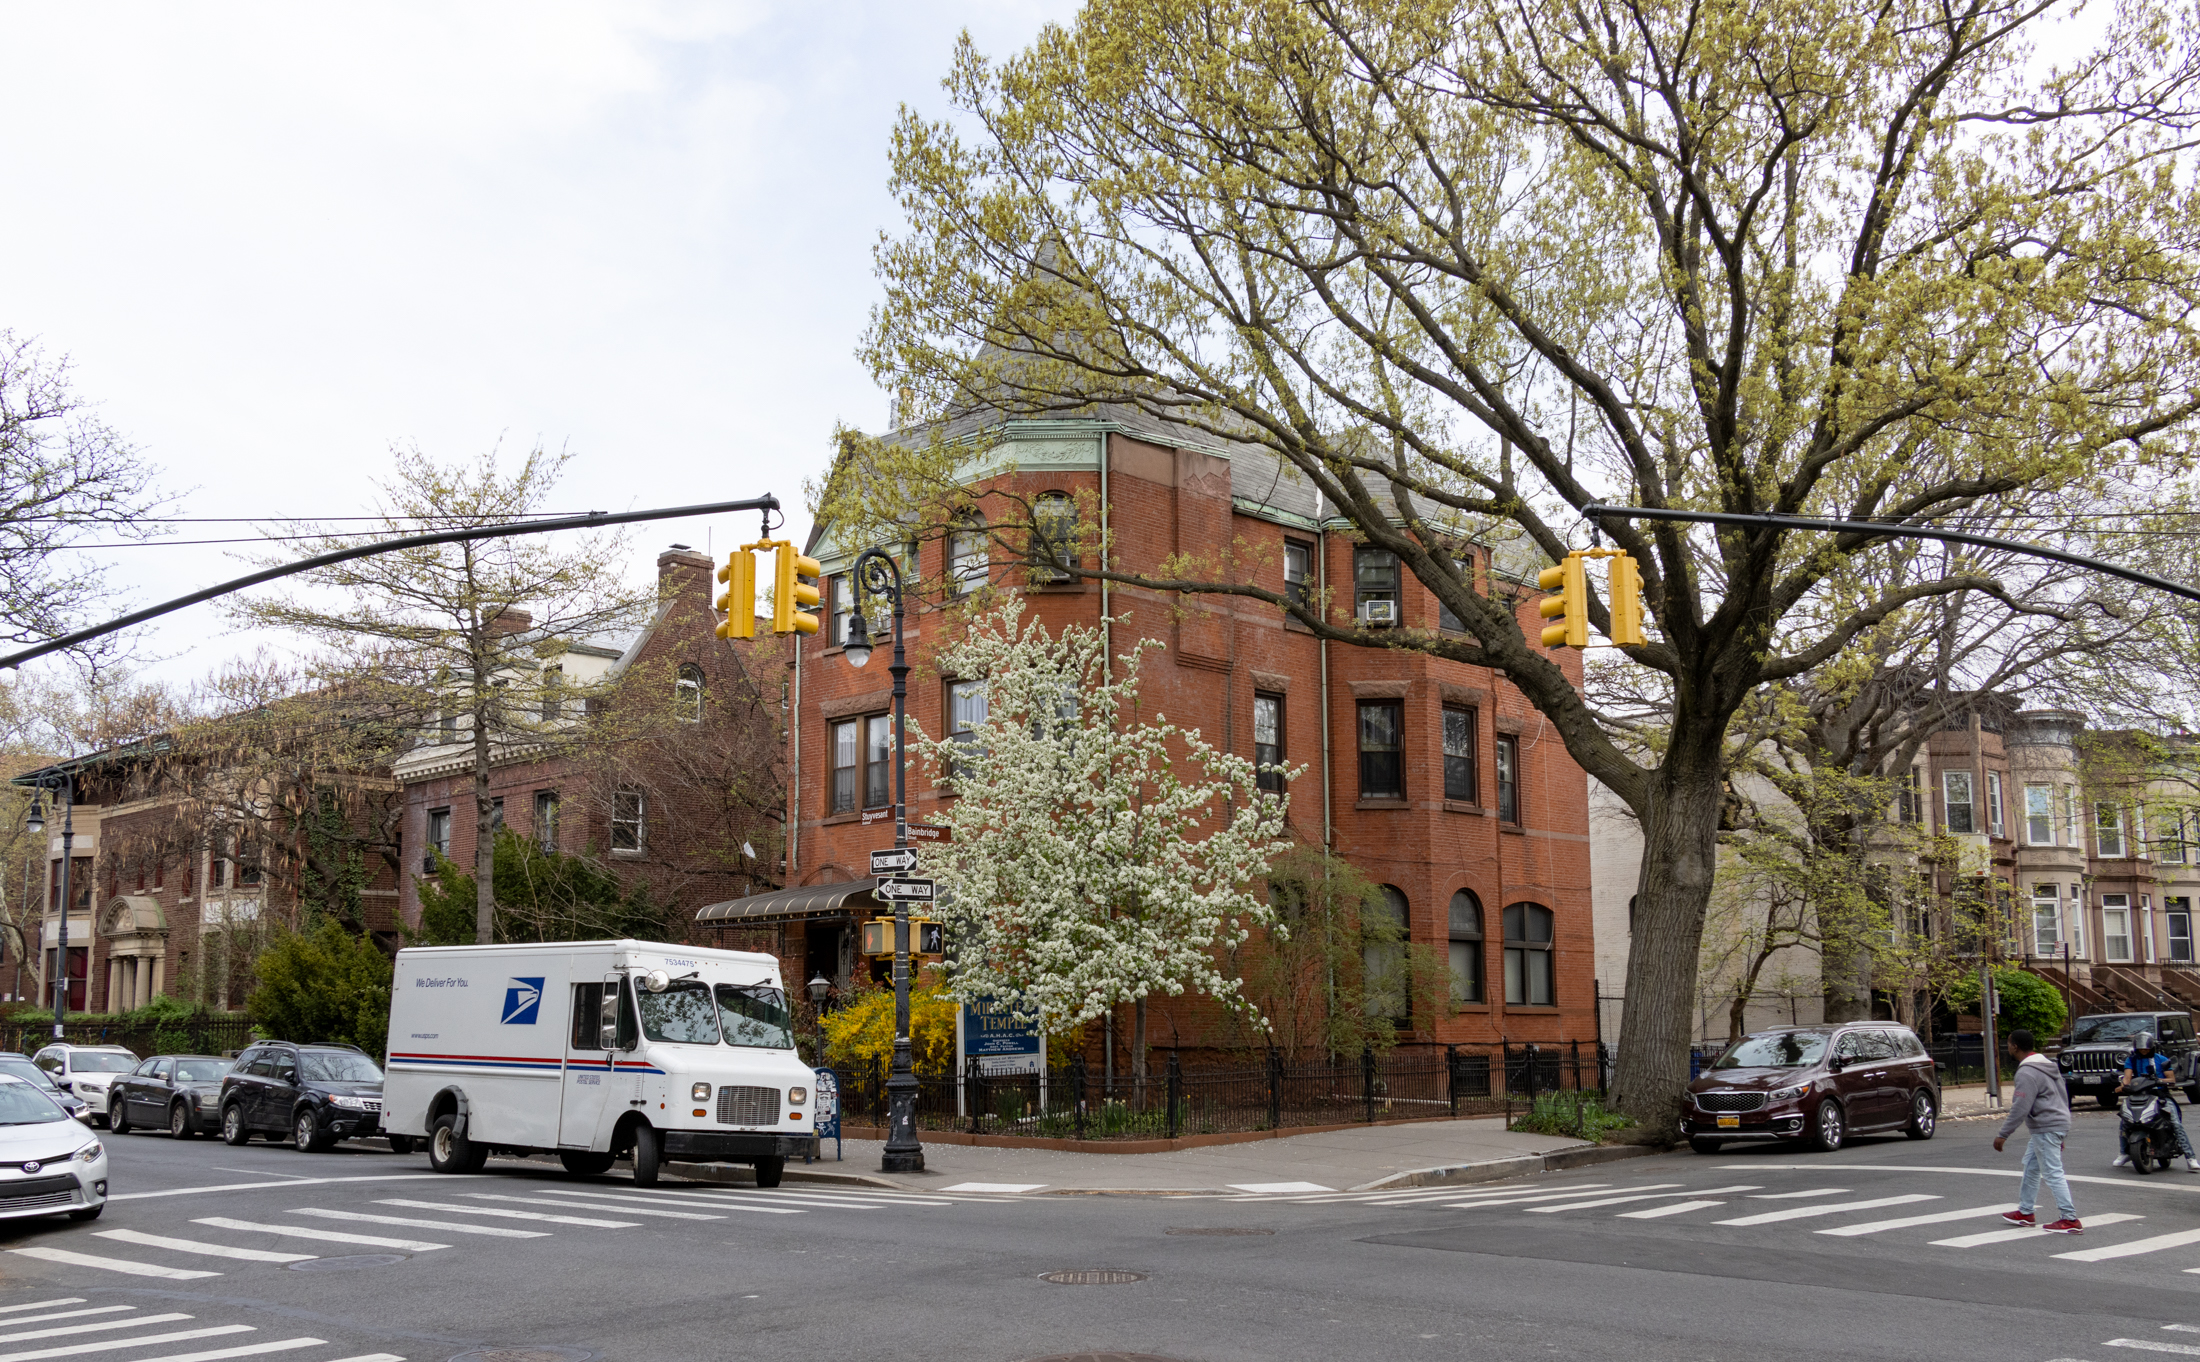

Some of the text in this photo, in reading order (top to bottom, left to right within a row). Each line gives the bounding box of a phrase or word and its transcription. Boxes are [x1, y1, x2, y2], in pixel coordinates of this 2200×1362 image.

[862, 809, 888, 822] Stuyvesant
[908, 827, 940, 839] Bainbridge
[875, 856, 911, 866] ONE WAY
[885, 884, 928, 894] ONE WAY
[664, 958, 694, 967] 7534475
[416, 978, 425, 987] We
[425, 978, 446, 987] Deliver
[446, 977, 457, 987] For
